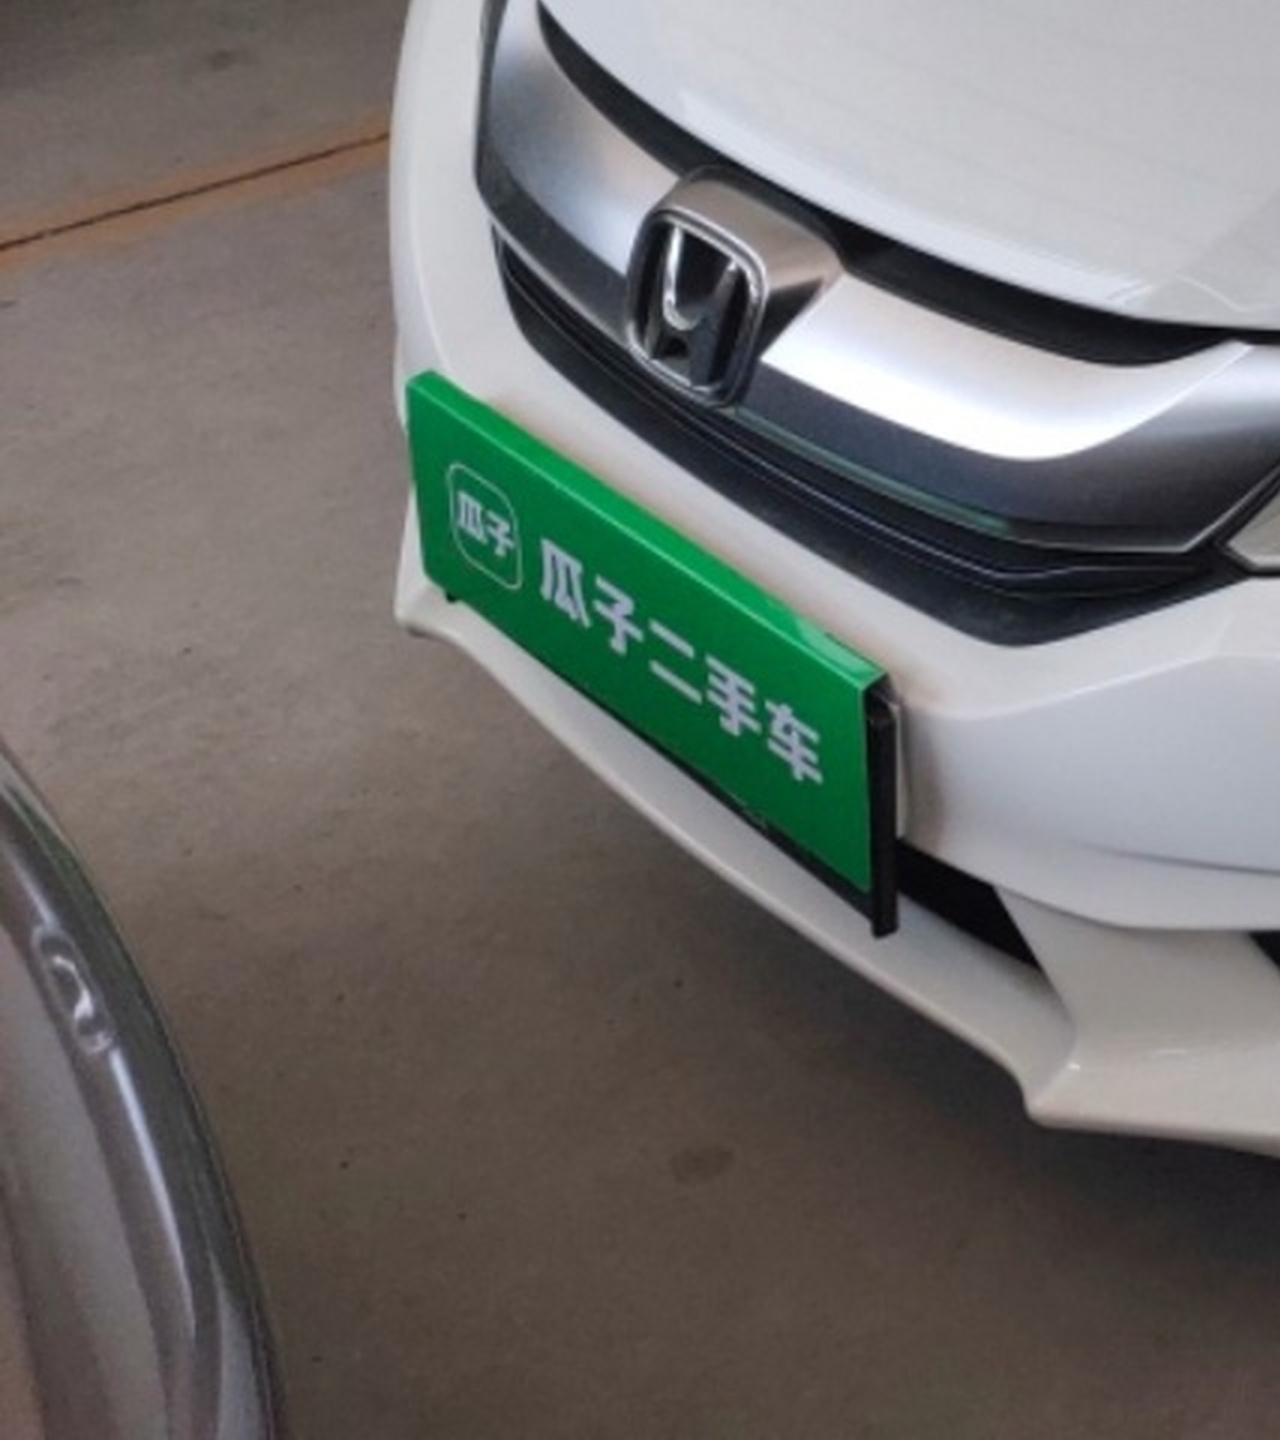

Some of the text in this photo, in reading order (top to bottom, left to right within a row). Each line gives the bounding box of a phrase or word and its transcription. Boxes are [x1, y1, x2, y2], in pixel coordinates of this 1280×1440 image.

[458, 490, 515, 557] 瓜子
[540, 538, 824, 785] 瓜子二手车
